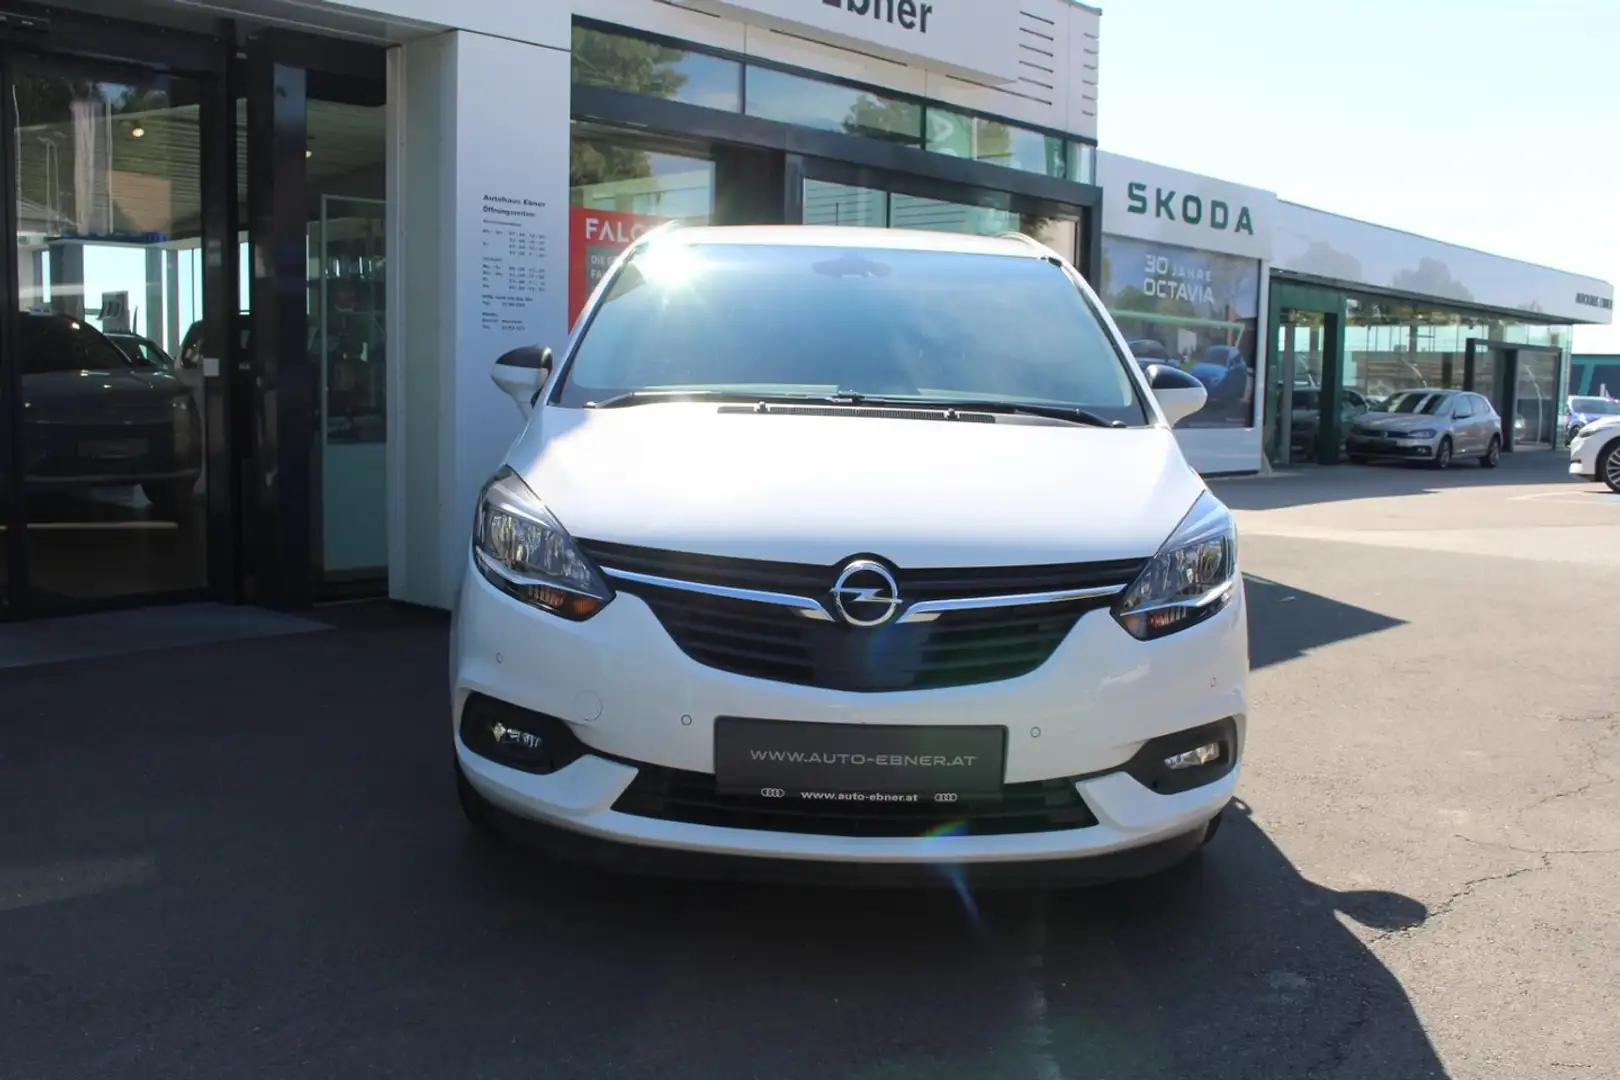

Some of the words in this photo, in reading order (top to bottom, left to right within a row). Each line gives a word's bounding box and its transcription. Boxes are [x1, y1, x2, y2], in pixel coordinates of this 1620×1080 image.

[822, 0, 932, 33] ner
[1127, 181, 1254, 236] SKODA
[1143, 278, 1214, 304] OCTAVIA
[750, 749, 978, 767] WWW.AUTO-EBNER.AT
[801, 791, 918, 802] www.auto-ebner.at
